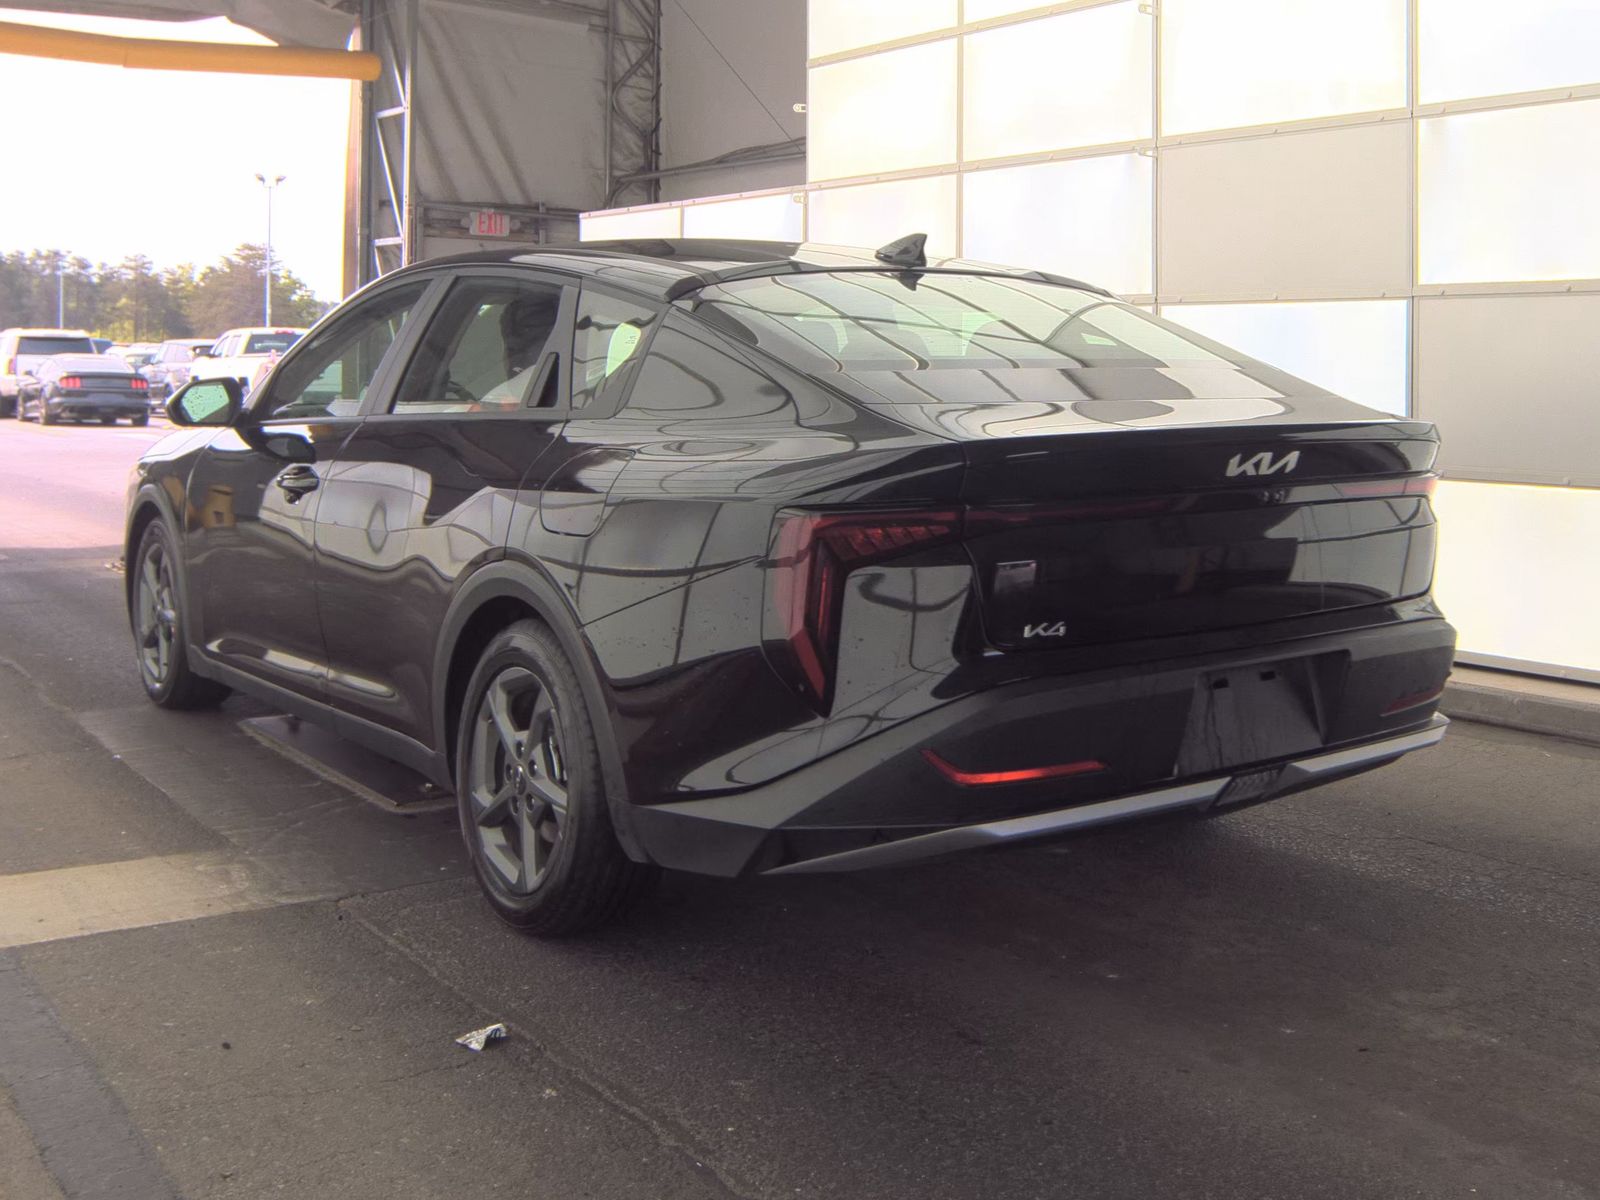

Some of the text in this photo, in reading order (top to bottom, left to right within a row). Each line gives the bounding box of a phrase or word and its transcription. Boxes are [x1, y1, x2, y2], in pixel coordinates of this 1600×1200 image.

[478, 211, 505, 235] EXIT
[1225, 450, 1300, 477] KIA
[1023, 621, 1066, 638] K4
